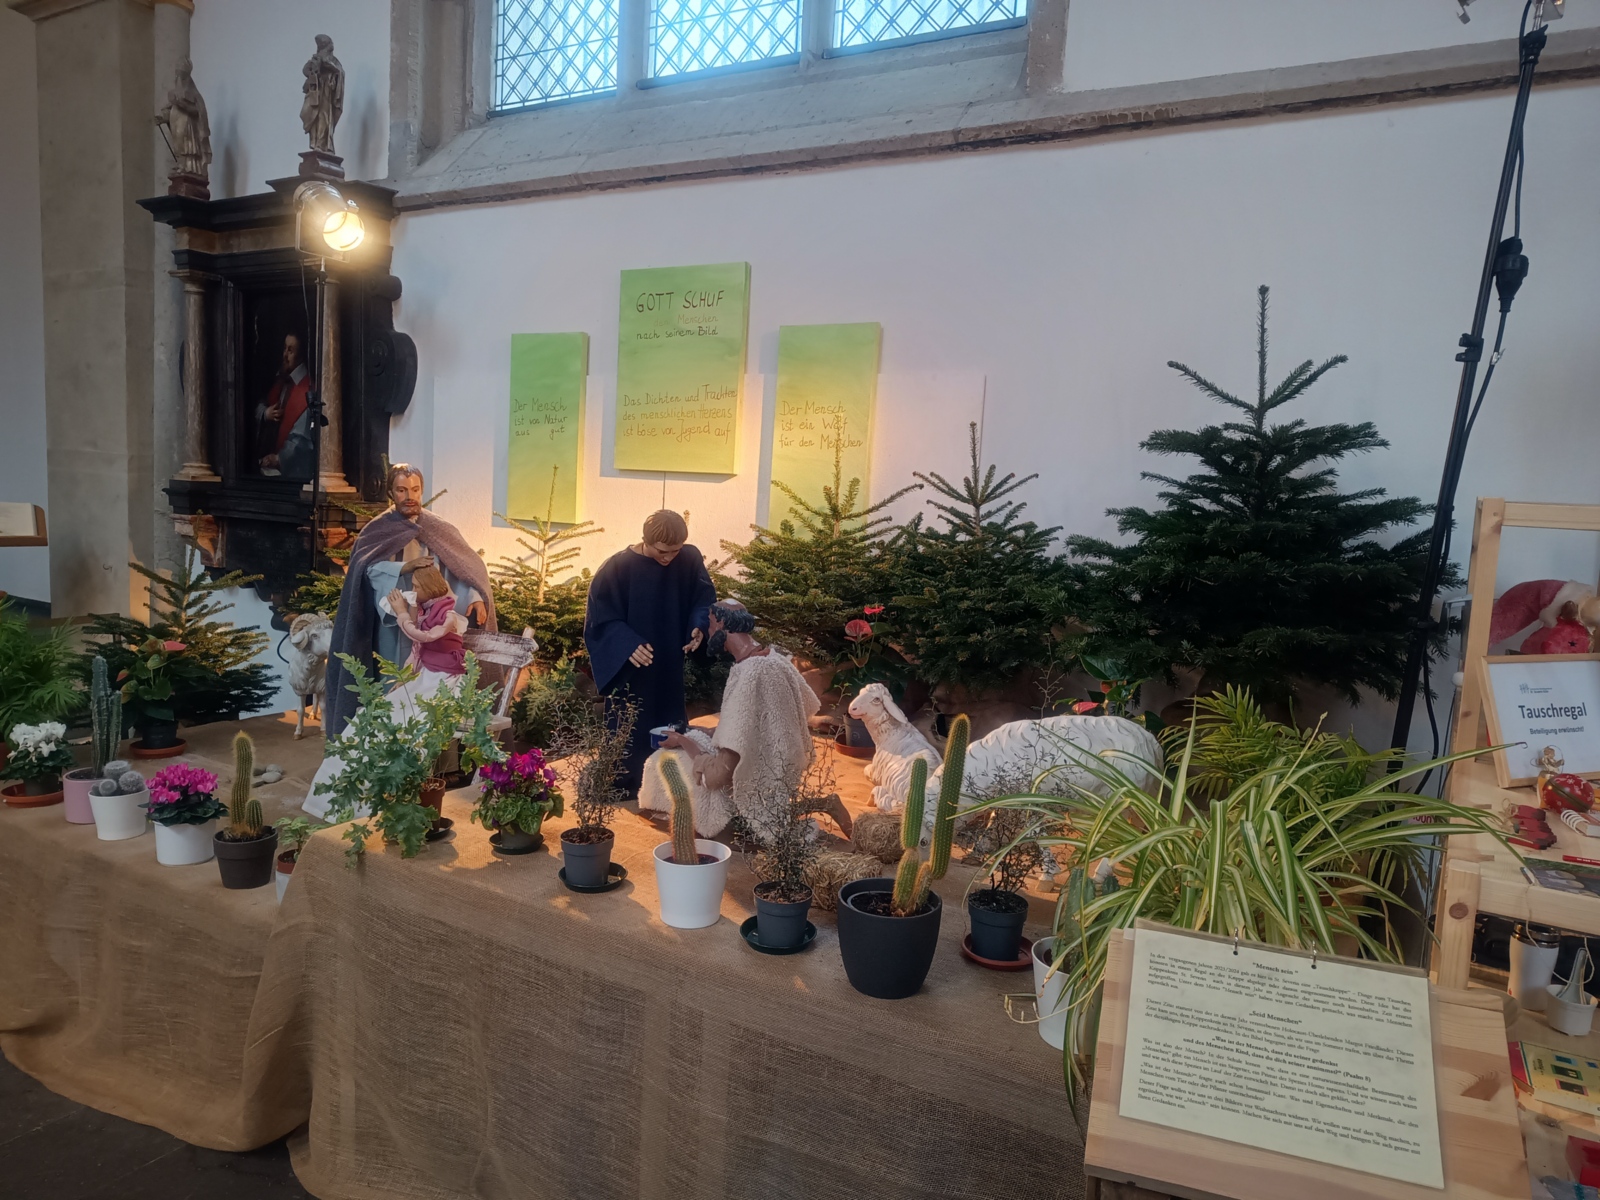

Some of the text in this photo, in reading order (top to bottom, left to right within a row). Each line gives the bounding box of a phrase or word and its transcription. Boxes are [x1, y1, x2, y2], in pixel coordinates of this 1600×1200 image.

[636, 290, 724, 312] GOTT SCHUF
[678, 314, 719, 324] Menschen
[637, 326, 718, 340] nach seinem Bild
[624, 384, 738, 406] Das Dichten und Trachten
[514, 397, 568, 412] Der Mensch
[622, 404, 732, 420] des menschlichen Herzens
[780, 400, 846, 416] Der Mensch
[514, 415, 524, 426] ist
[544, 414, 568, 424] Natur
[781, 418, 794, 431] ist
[799, 418, 815, 430] ein
[549, 425, 565, 440] gut
[623, 425, 633, 436] ist
[637, 424, 657, 436] böse
[676, 418, 710, 443] Jugend
[714, 422, 732, 444] auf
[779, 434, 794, 448] für
[799, 436, 814, 447] den
[1518, 702, 1587, 720] Tauschregal
[1246, 1043, 1270, 1053] Mensch,
[1312, 1059, 1338, 1067] gedenkst
